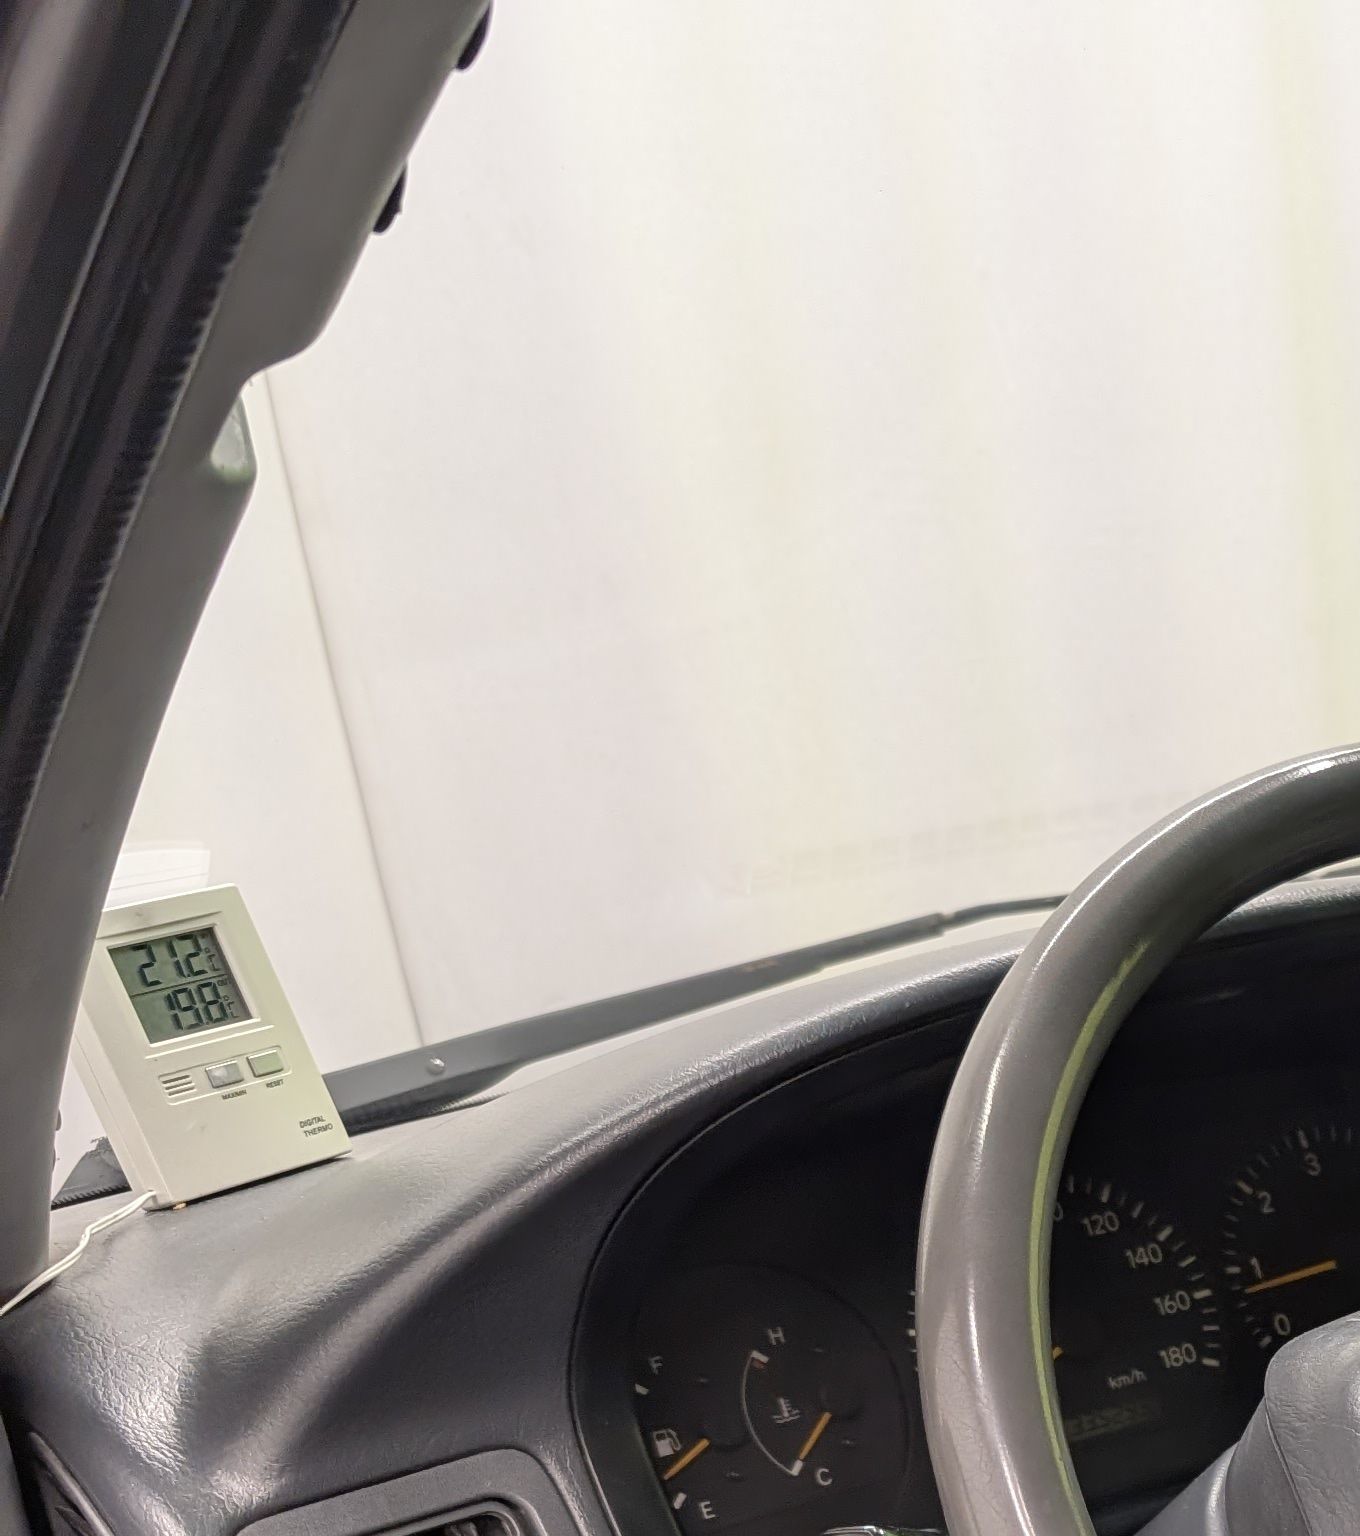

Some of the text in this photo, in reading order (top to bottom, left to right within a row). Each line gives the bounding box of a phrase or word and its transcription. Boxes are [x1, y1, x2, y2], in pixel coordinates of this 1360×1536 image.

[299, 1115, 326, 1128] DIGITAL
[304, 1123, 333, 1137] THERMO
[1304, 1152, 1321, 1177] 3
[1257, 1190, 1275, 1214] 2
[1081, 1210, 1120, 1236] 120
[1125, 1243, 1163, 1269] 140
[1154, 1290, 1191, 1316] 160
[767, 1326, 785, 1345] H
[1273, 1313, 1291, 1336] 0
[1159, 1342, 1197, 1369] 180
[1106, 1368, 1147, 1390] km/h
[816, 1467, 833, 1486] C
[700, 1500, 716, 1520] E
